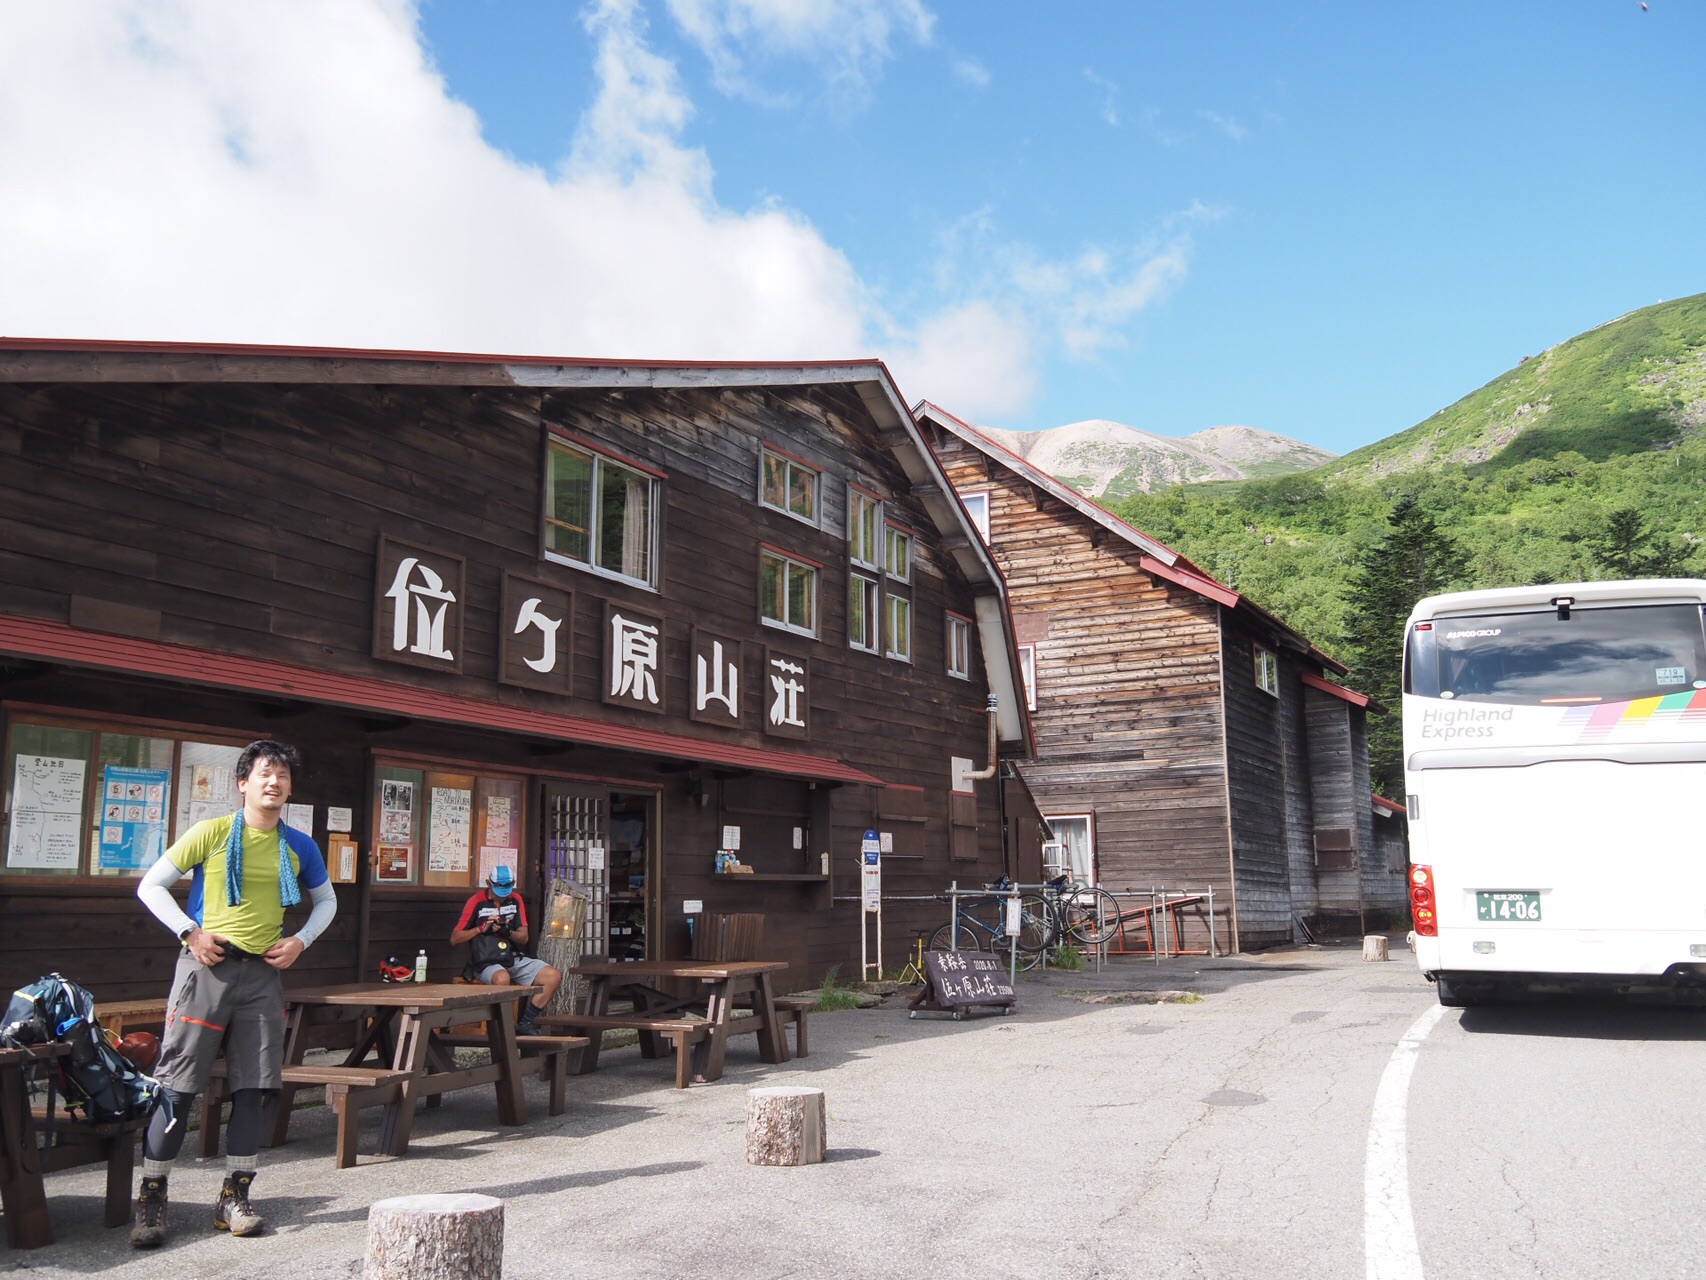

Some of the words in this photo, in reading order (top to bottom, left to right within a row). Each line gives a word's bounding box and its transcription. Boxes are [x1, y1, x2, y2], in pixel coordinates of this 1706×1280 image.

[1423, 707, 1514, 726] Highland
[1421, 724, 1494, 741] Express
[1490, 900, 1539, 919] 14-06
